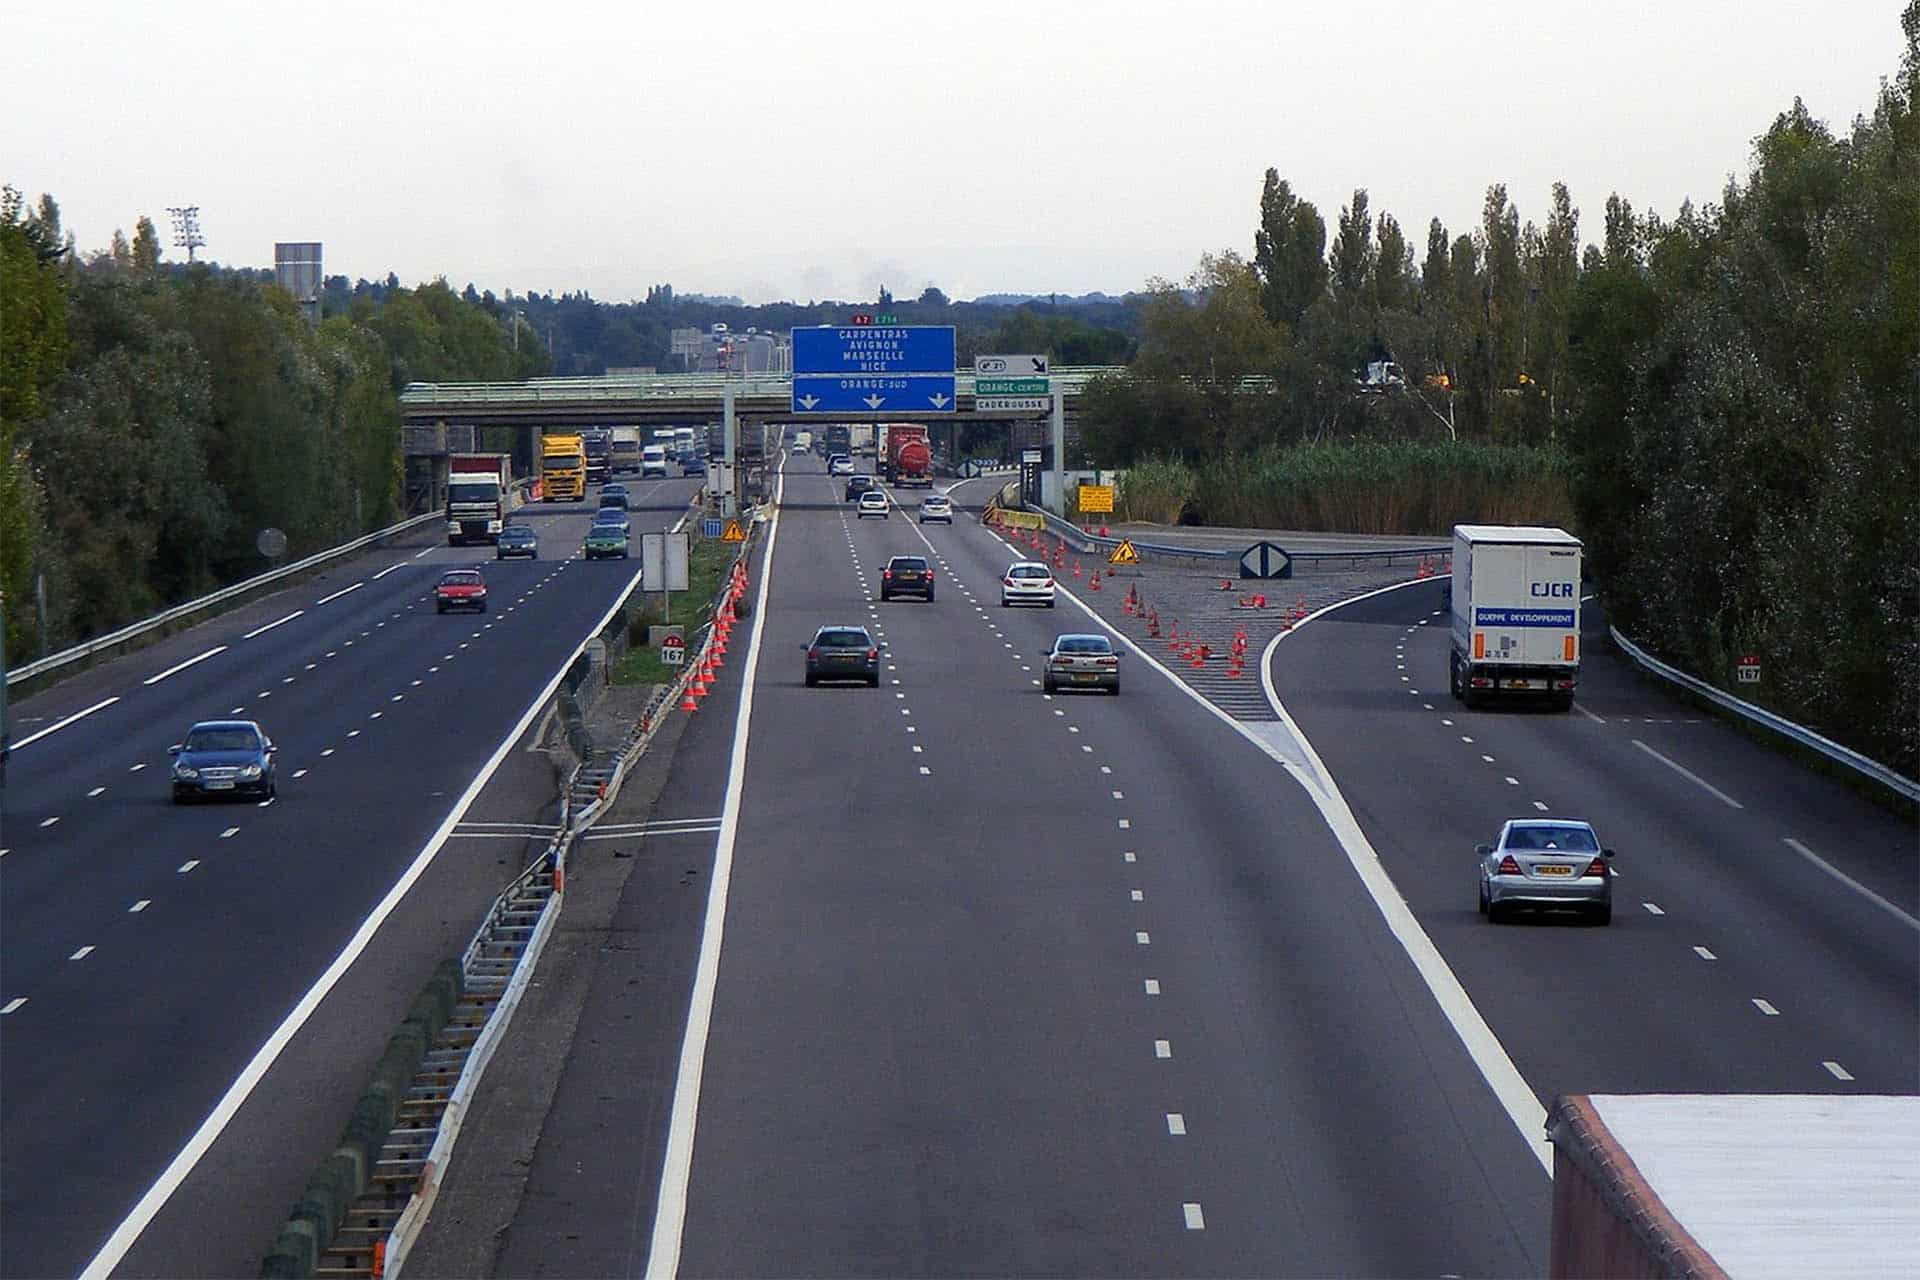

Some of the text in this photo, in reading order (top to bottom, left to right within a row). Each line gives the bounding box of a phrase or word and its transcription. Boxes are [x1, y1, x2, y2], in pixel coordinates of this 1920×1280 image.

[839, 329, 908, 339] CARPENTRAS
[850, 340, 898, 350] AVIGNON
[843, 351, 904, 361] MARSEILLE
[860, 361, 887, 371] NICE
[978, 400, 1042, 408] CADEROUSSE
[1531, 583, 1573, 597] CJCR
[663, 650, 683, 660] 167
[1739, 669, 1760, 679] 167
